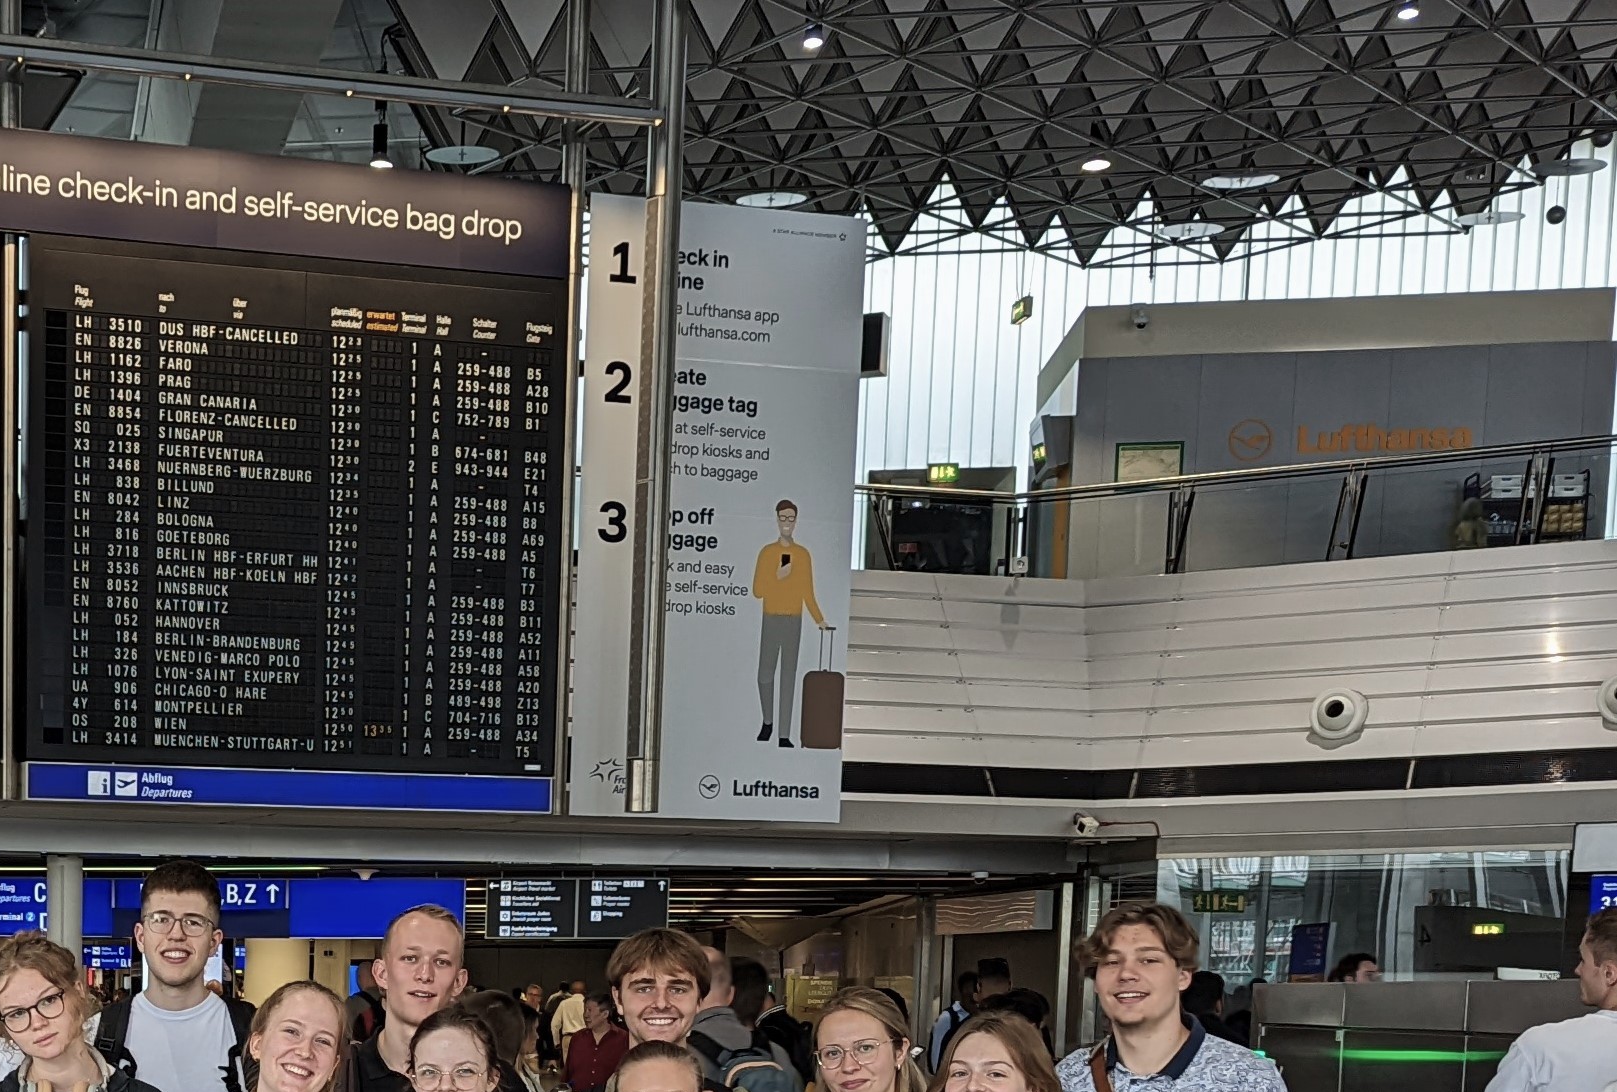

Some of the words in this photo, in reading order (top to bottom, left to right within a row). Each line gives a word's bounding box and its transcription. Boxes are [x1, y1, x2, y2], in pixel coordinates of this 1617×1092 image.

[59, 171, 177, 207] check-in
[186, 187, 236, 213] and
[244, 191, 398, 227] self-service
[407, 203, 454, 239] bag
[462, 210, 521, 245] drop
[610, 242, 636, 284] 1
[714, 250, 728, 268] in
[687, 302, 751, 320] Lufthansa
[755, 312, 779, 325] app
[159, 321, 184, 336] DUS
[192, 324, 299, 345] HBF-CANCELLED
[676, 321, 772, 342] lufthansa.com
[159, 340, 208, 354] VERONA
[160, 357, 191, 371] FARO
[159, 374, 191, 388] PRAG
[605, 361, 631, 403] 2
[674, 368, 707, 386] ate
[728, 396, 757, 417] tag
[159, 426, 223, 442] SINGAPUR
[675, 423, 688, 434] at
[691, 423, 766, 439] self-service
[1297, 422, 1473, 454] Lufthansa
[159, 444, 263, 462] FUERTEVENTURA
[702, 443, 742, 458] kiosks
[746, 448, 769, 460] and
[671, 462, 681, 476] h
[684, 464, 697, 476] to
[701, 464, 758, 482] baggage
[158, 496, 189, 509] LINZ
[158, 513, 213, 527] BOLOGNA
[598, 501, 627, 543] 3
[669, 509, 684, 527] p
[688, 508, 714, 524] off
[157, 530, 229, 545] GOETEBORG
[677, 560, 701, 573] and
[705, 564, 734, 578] easy
[159, 582, 228, 596] INNSBRUCK
[675, 580, 748, 596] self-service
[696, 601, 735, 615] kiosks
[156, 616, 219, 630] HANNOVER
[155, 684, 227, 699] CHICAGO-O
[236, 687, 268, 701] HARE
[155, 718, 186, 730] WIEN
[141, 772, 173, 786] Abflug
[141, 787, 193, 800] Departures
[733, 780, 819, 798] Lufthansa
[34, 883, 46, 903] C
